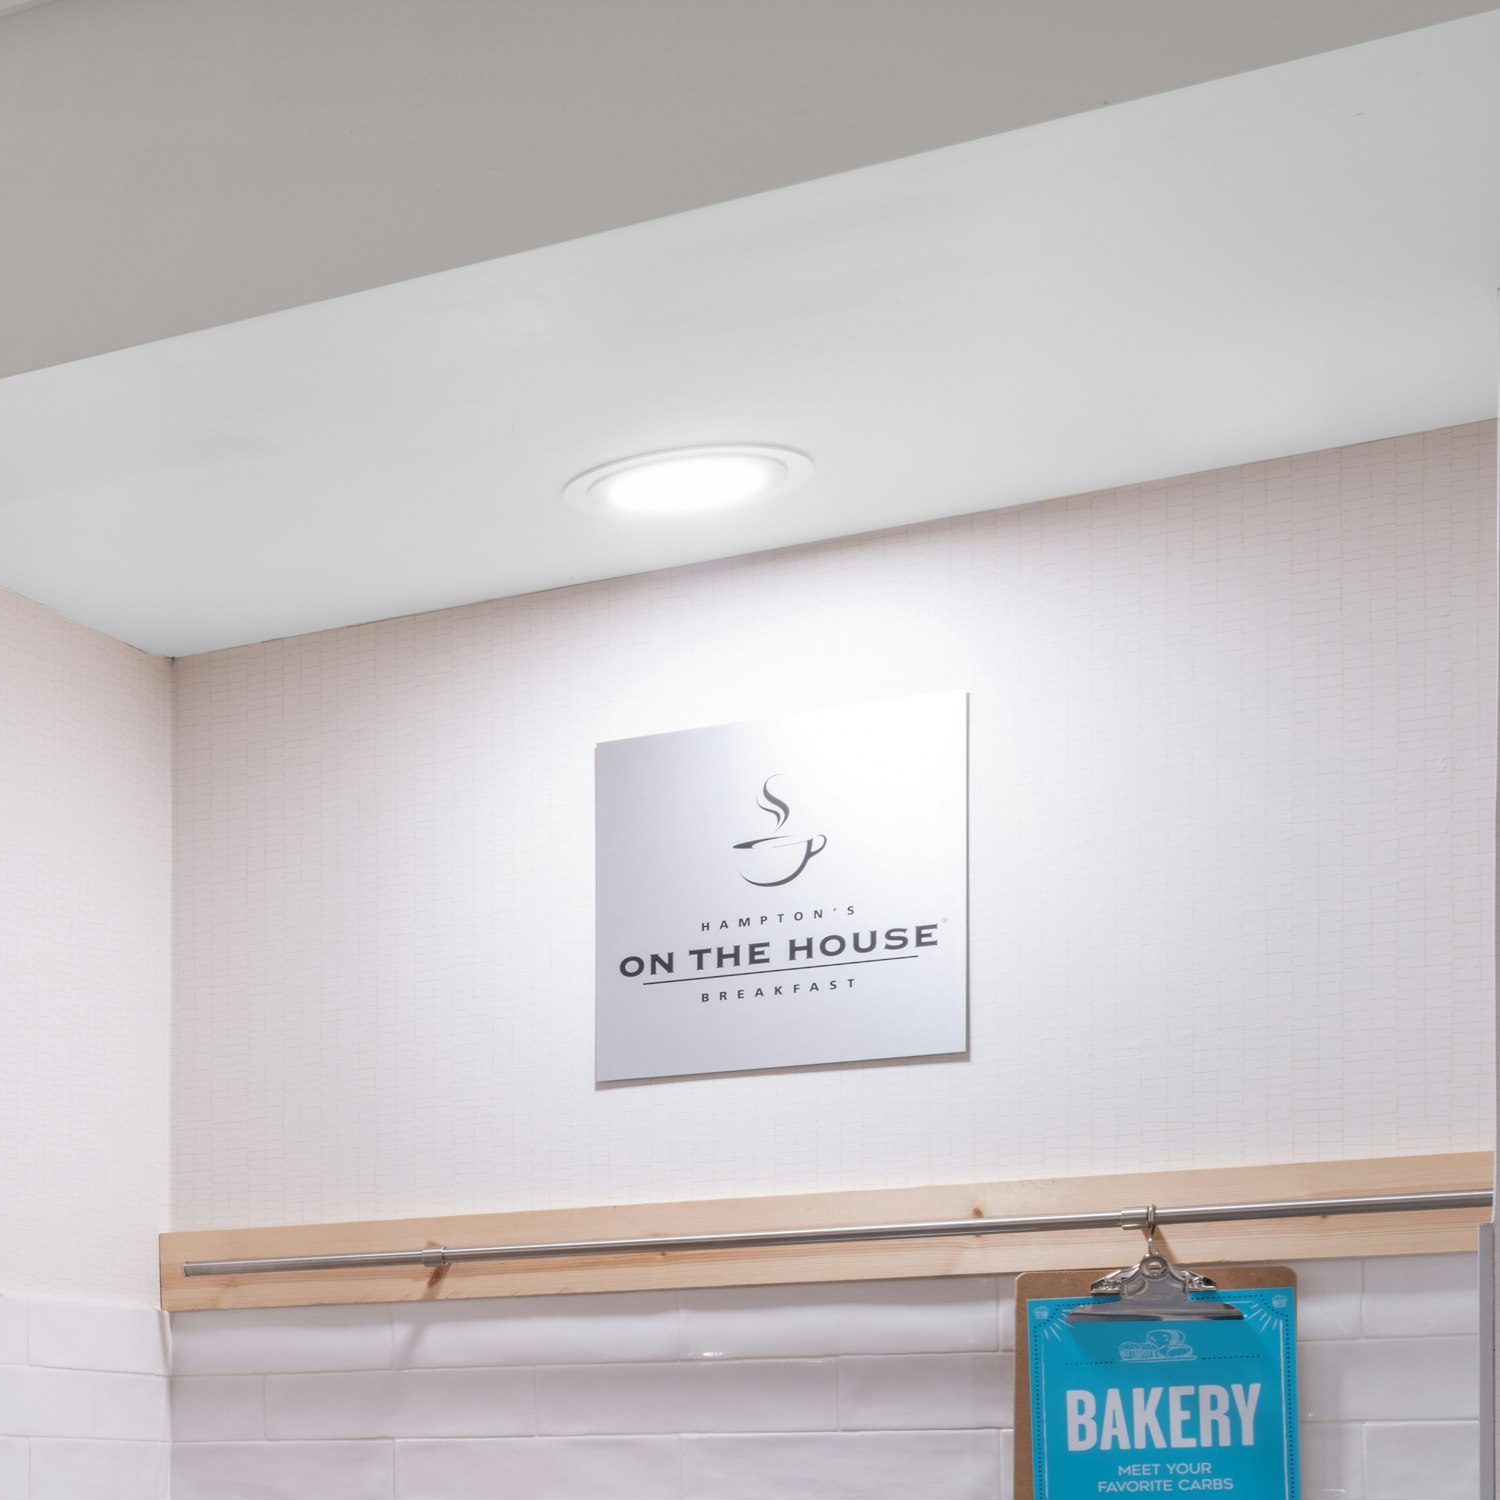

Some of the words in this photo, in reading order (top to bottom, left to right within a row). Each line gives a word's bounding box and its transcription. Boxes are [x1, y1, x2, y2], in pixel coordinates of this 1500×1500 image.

[701, 905, 855, 932] HAMPTON'S
[619, 952, 675, 978] ON
[689, 941, 770, 971] THE
[788, 923, 938, 961] HOUSE
[701, 978, 855, 1003] BREAKFAST
[1066, 1383, 1261, 1452] BAKERY
[1118, 1464, 1160, 1476] MEET
[1166, 1462, 1212, 1476] YOUR
[1098, 1480, 1173, 1493] FAVORITE
[1178, 1477, 1234, 1491] CARBS
